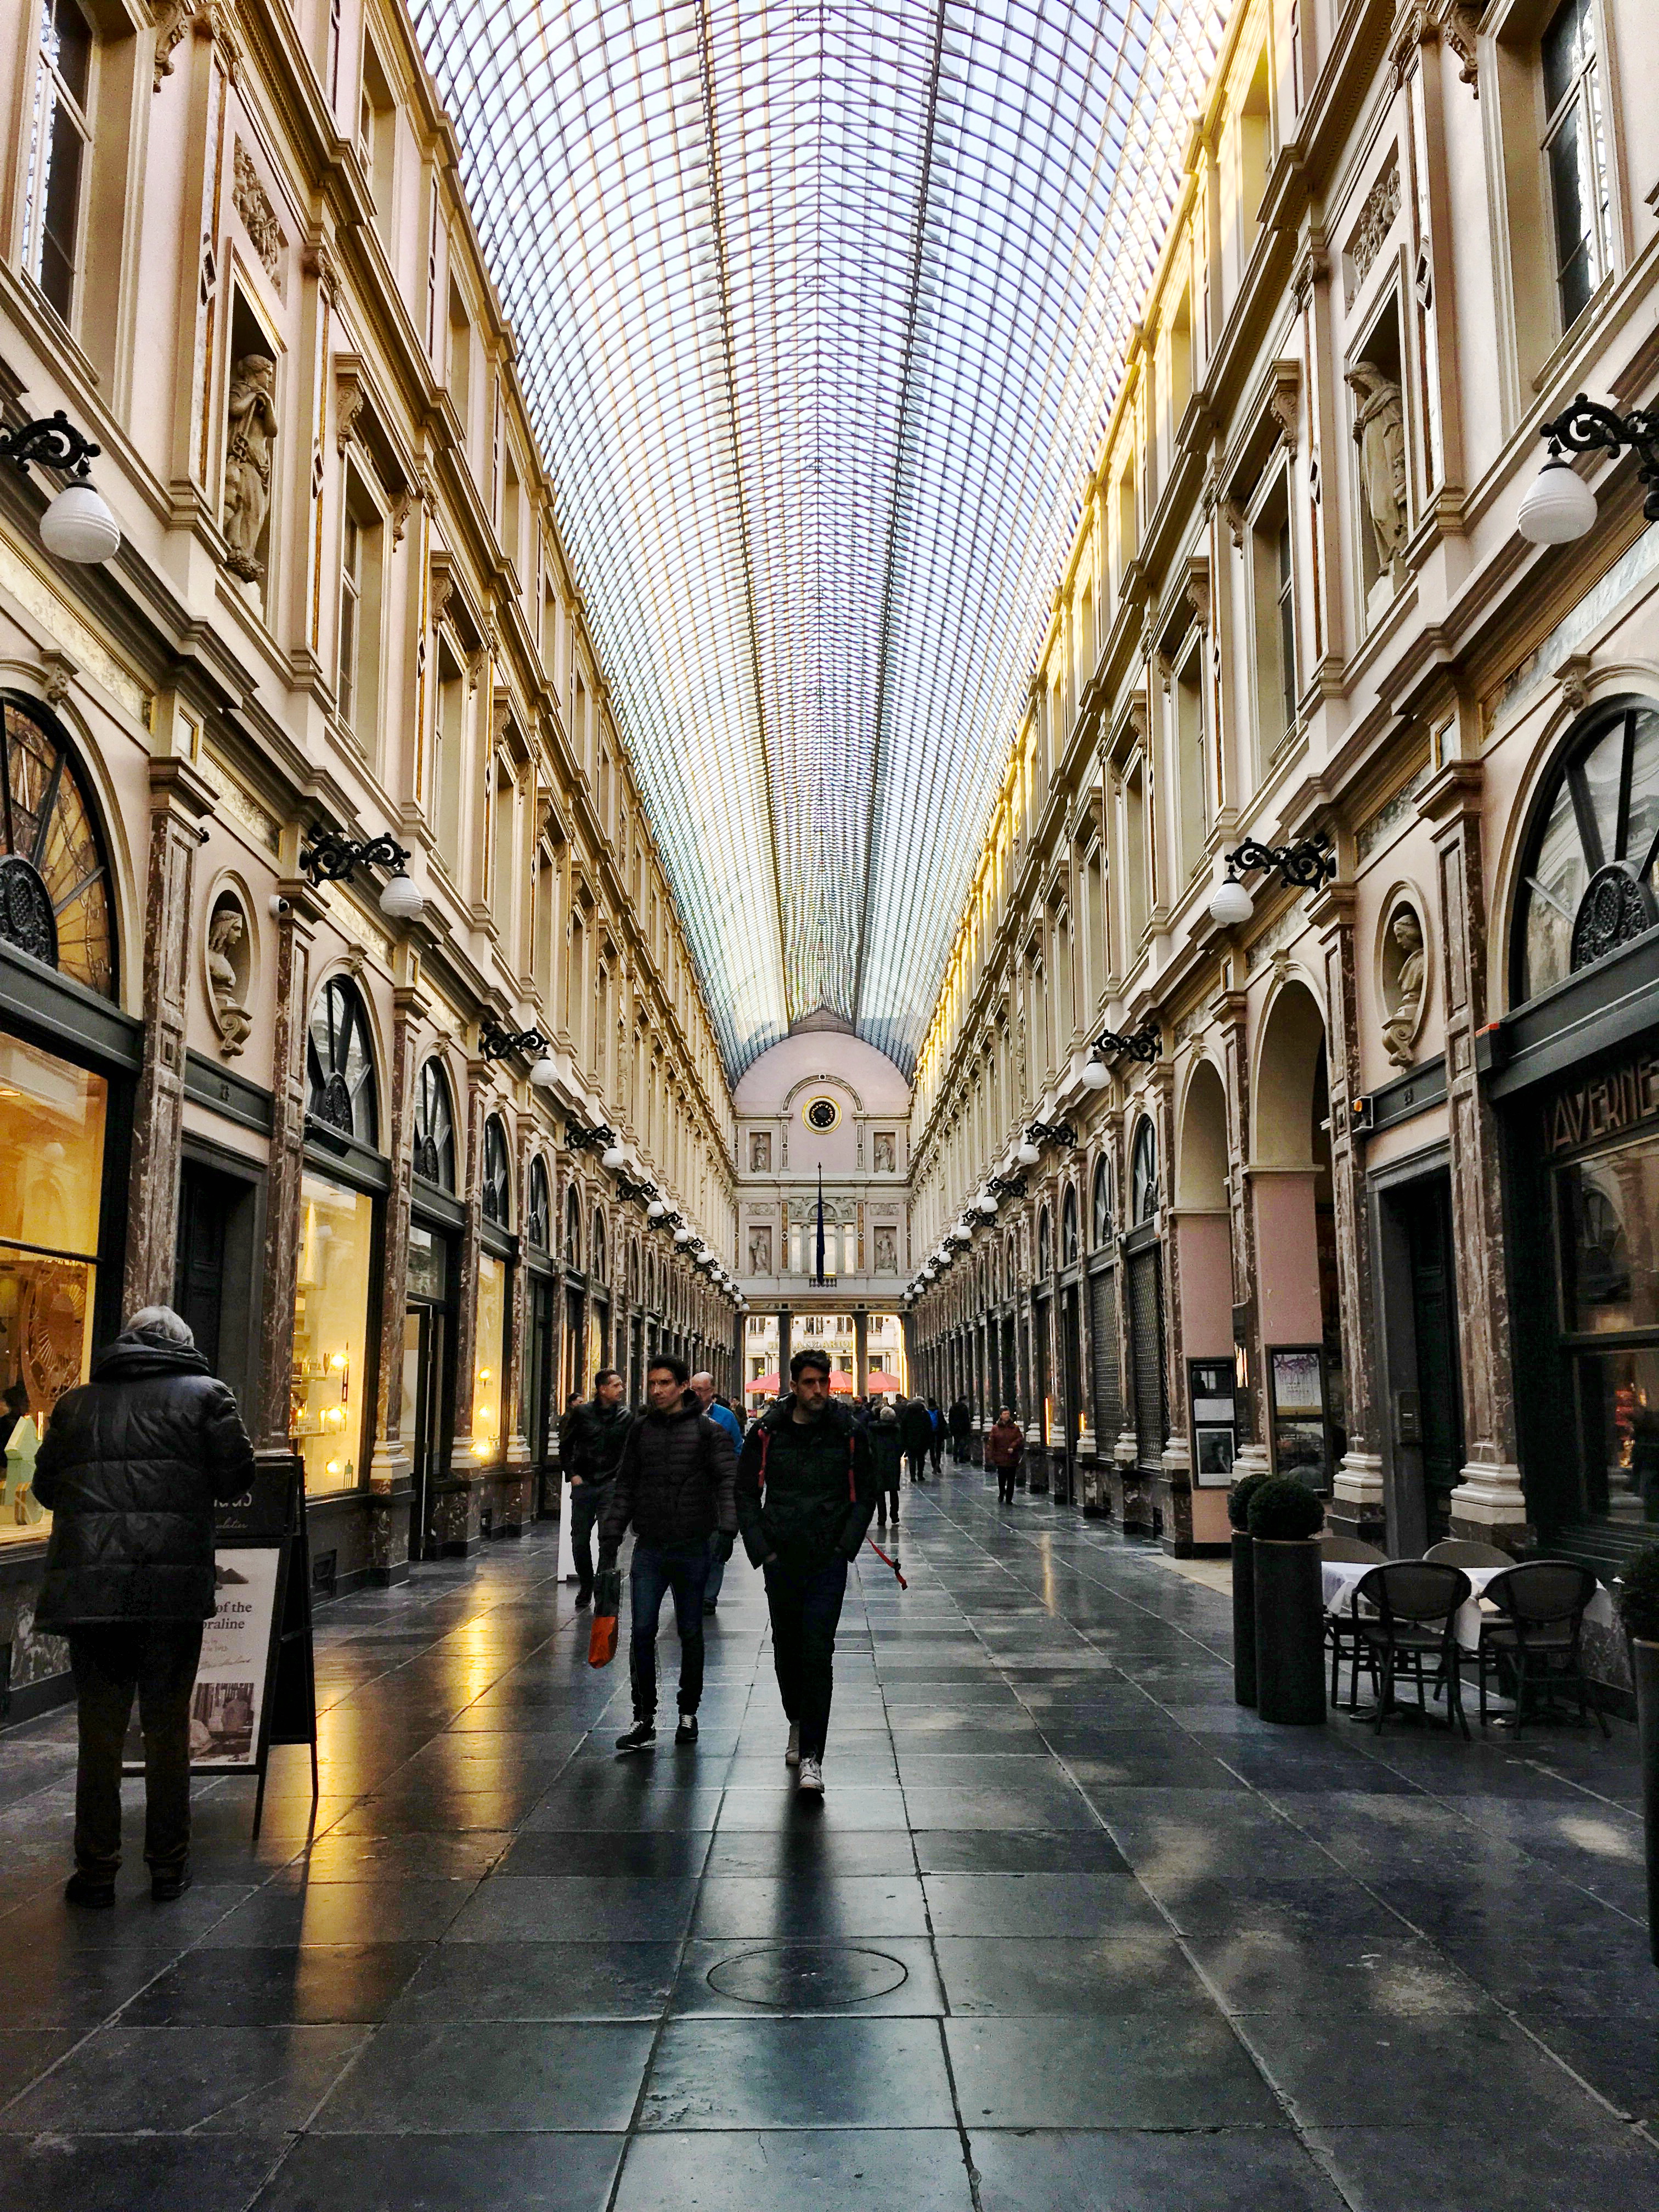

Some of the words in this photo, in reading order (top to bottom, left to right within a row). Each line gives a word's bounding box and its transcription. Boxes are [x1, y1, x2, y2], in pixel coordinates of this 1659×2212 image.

[768, 1341, 803, 1349] STLA
[822, 1340, 853, 1348] ARTOI
[216, 1601, 230, 1612] of
[232, 1602, 252, 1612] the
